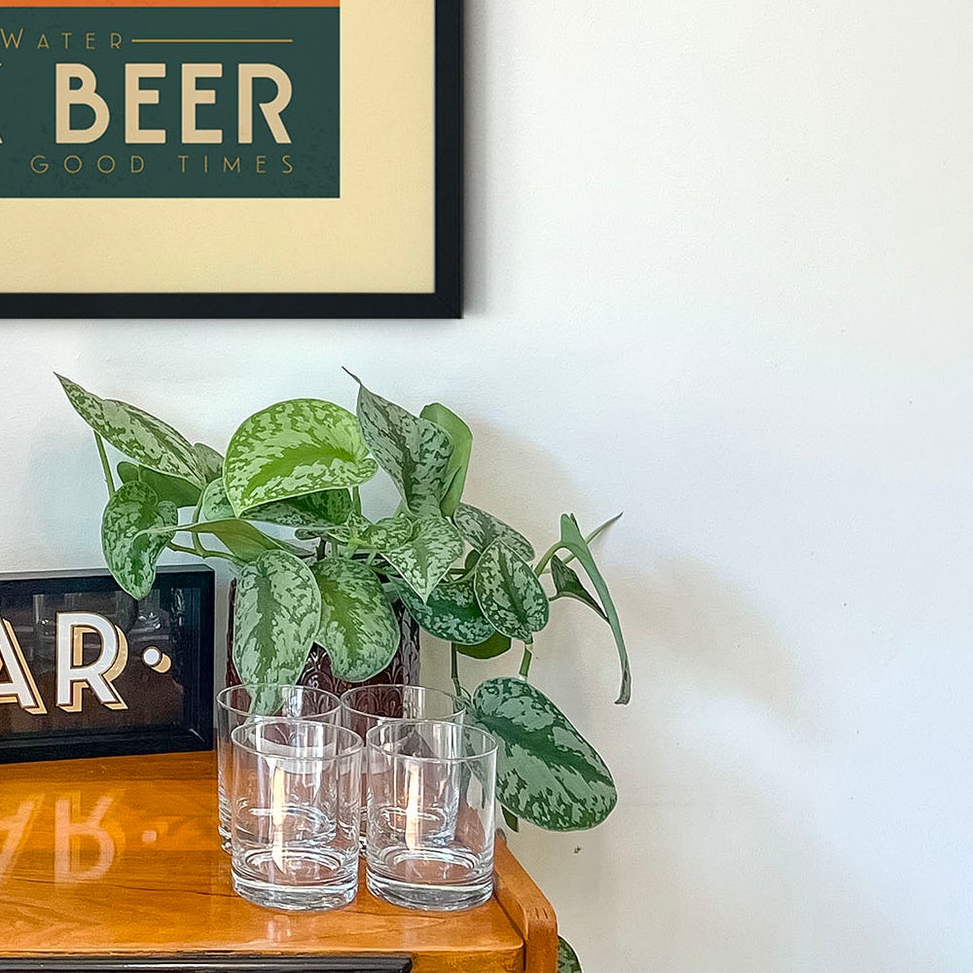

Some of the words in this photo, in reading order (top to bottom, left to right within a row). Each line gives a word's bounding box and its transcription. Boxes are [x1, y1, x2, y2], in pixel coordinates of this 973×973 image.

[55, 63, 292, 144] BEER
[30, 155, 145, 174] GOOD
[179, 155, 293, 174] TIMES
